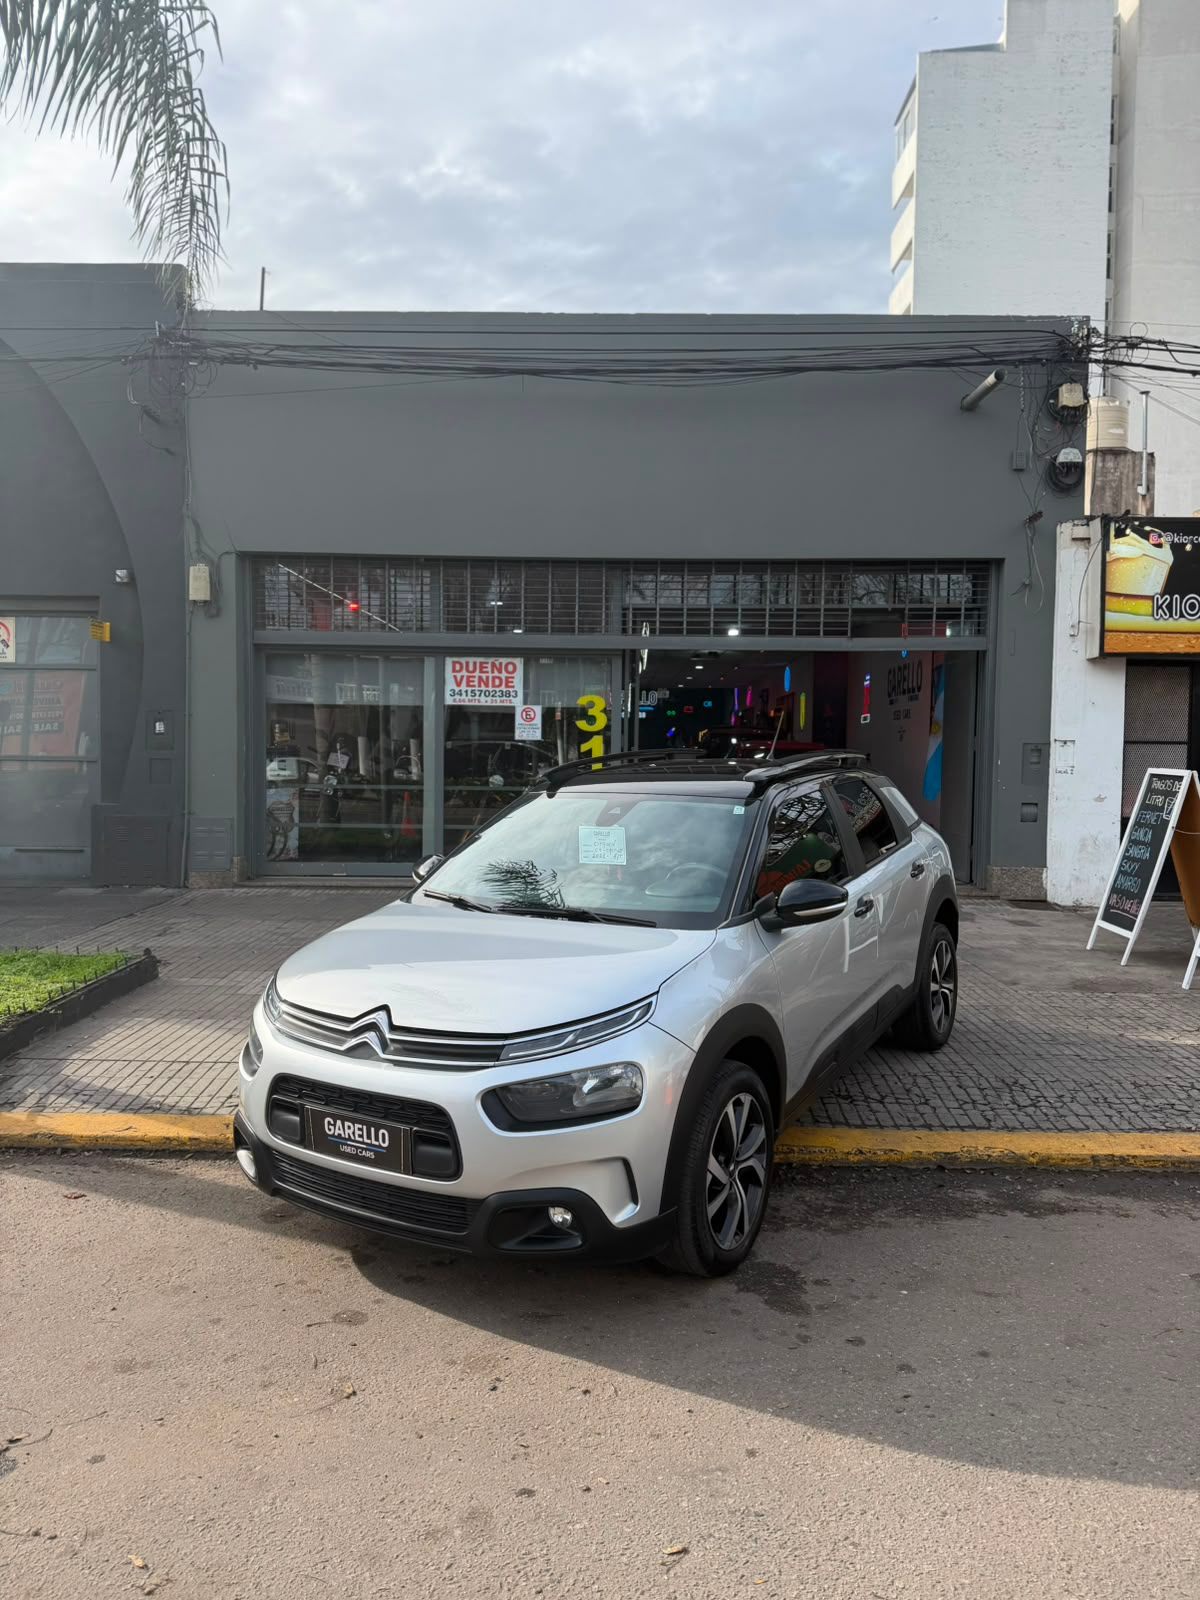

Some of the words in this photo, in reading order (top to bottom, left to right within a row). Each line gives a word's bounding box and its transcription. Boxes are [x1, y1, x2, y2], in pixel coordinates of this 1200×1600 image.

[451, 659, 517, 675] DUEÑO
[453, 675, 515, 688] VENDE
[887, 660, 923, 698] GARELLO
[449, 689, 518, 698] 3415702383
[1136, 810, 1164, 825] FERNET
[324, 1117, 390, 1148] GARELLO
[339, 1144, 357, 1155] USED
[357, 1149, 375, 1159] CARS
